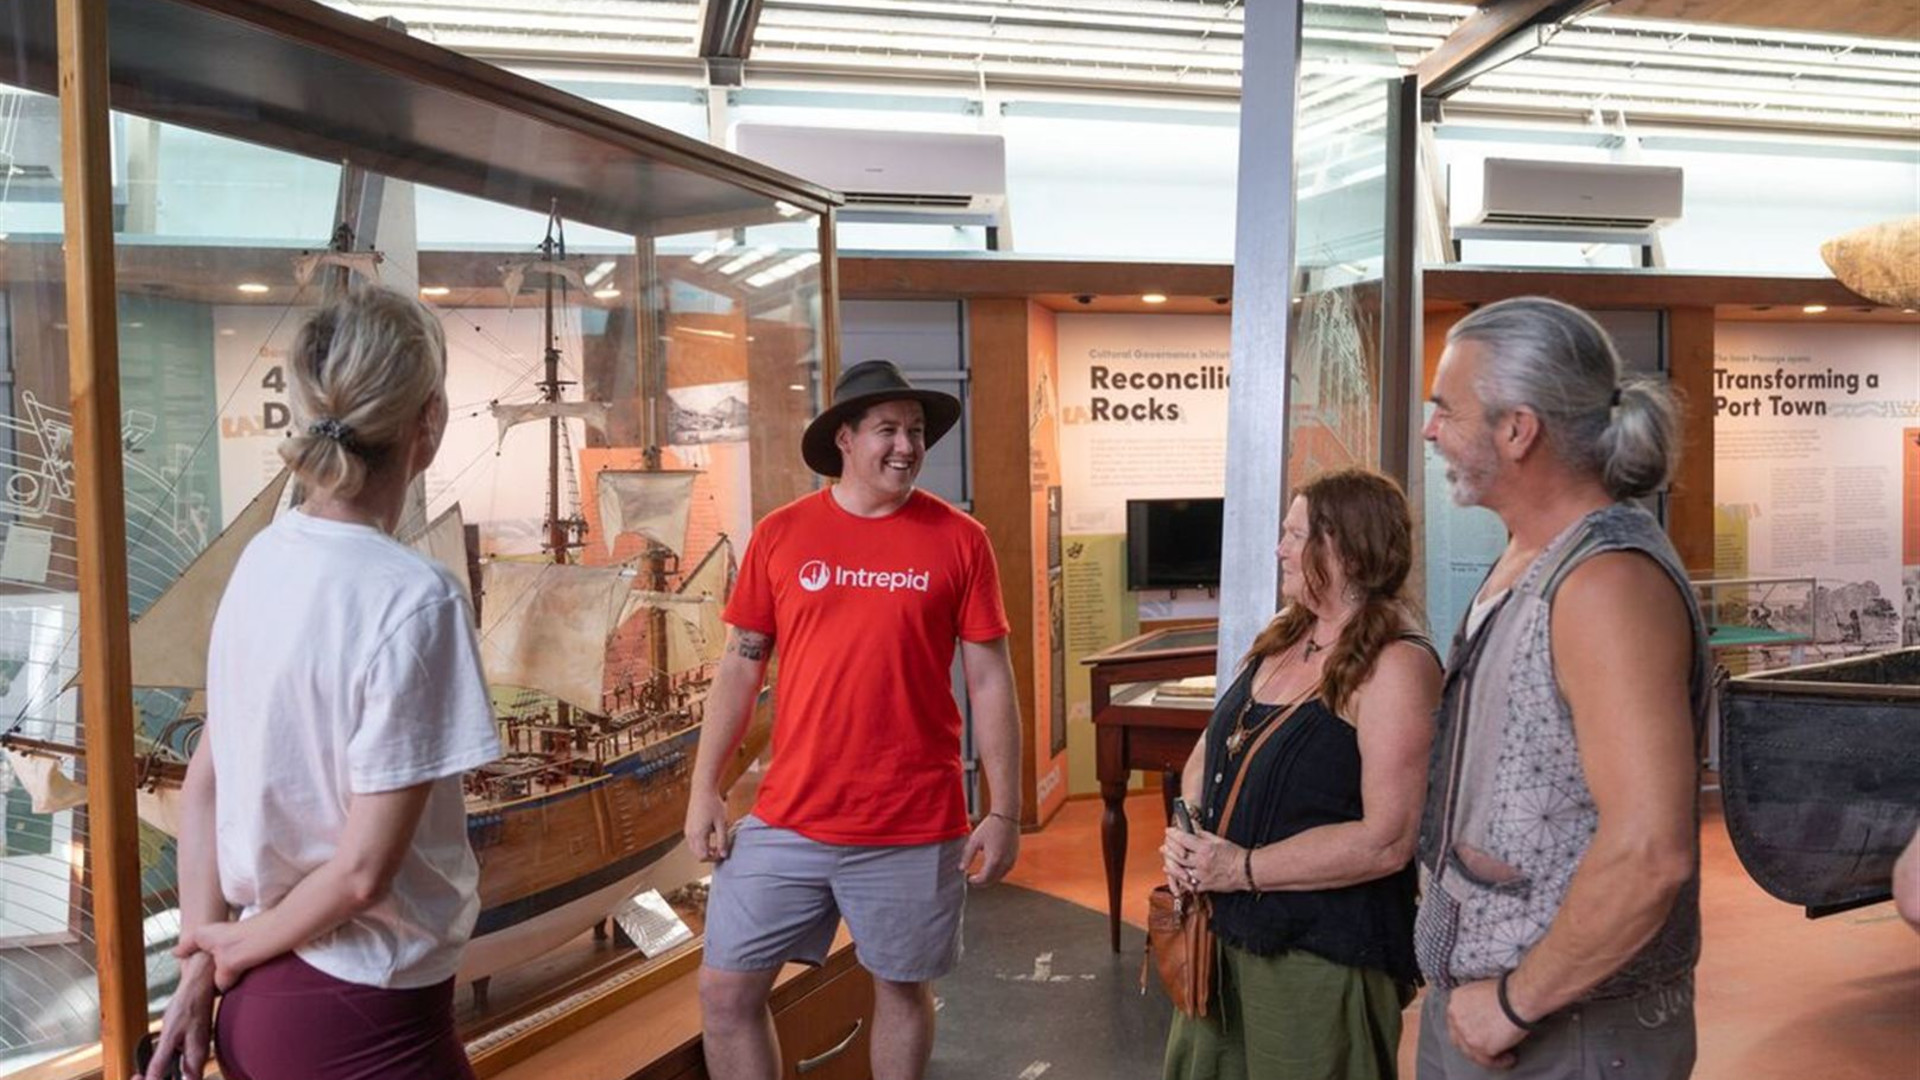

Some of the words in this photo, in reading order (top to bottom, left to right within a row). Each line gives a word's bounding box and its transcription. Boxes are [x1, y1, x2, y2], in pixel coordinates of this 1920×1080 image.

[1089, 349, 1131, 359] Cultural
[1134, 349, 1196, 359] Governance
[1714, 368, 1859, 395] Transforming
[1866, 374, 1879, 389] a
[1091, 398, 1179, 421] Rocks
[1714, 396, 1761, 417] Port
[1768, 396, 1827, 416] Town
[835, 565, 930, 592] Intrepid
